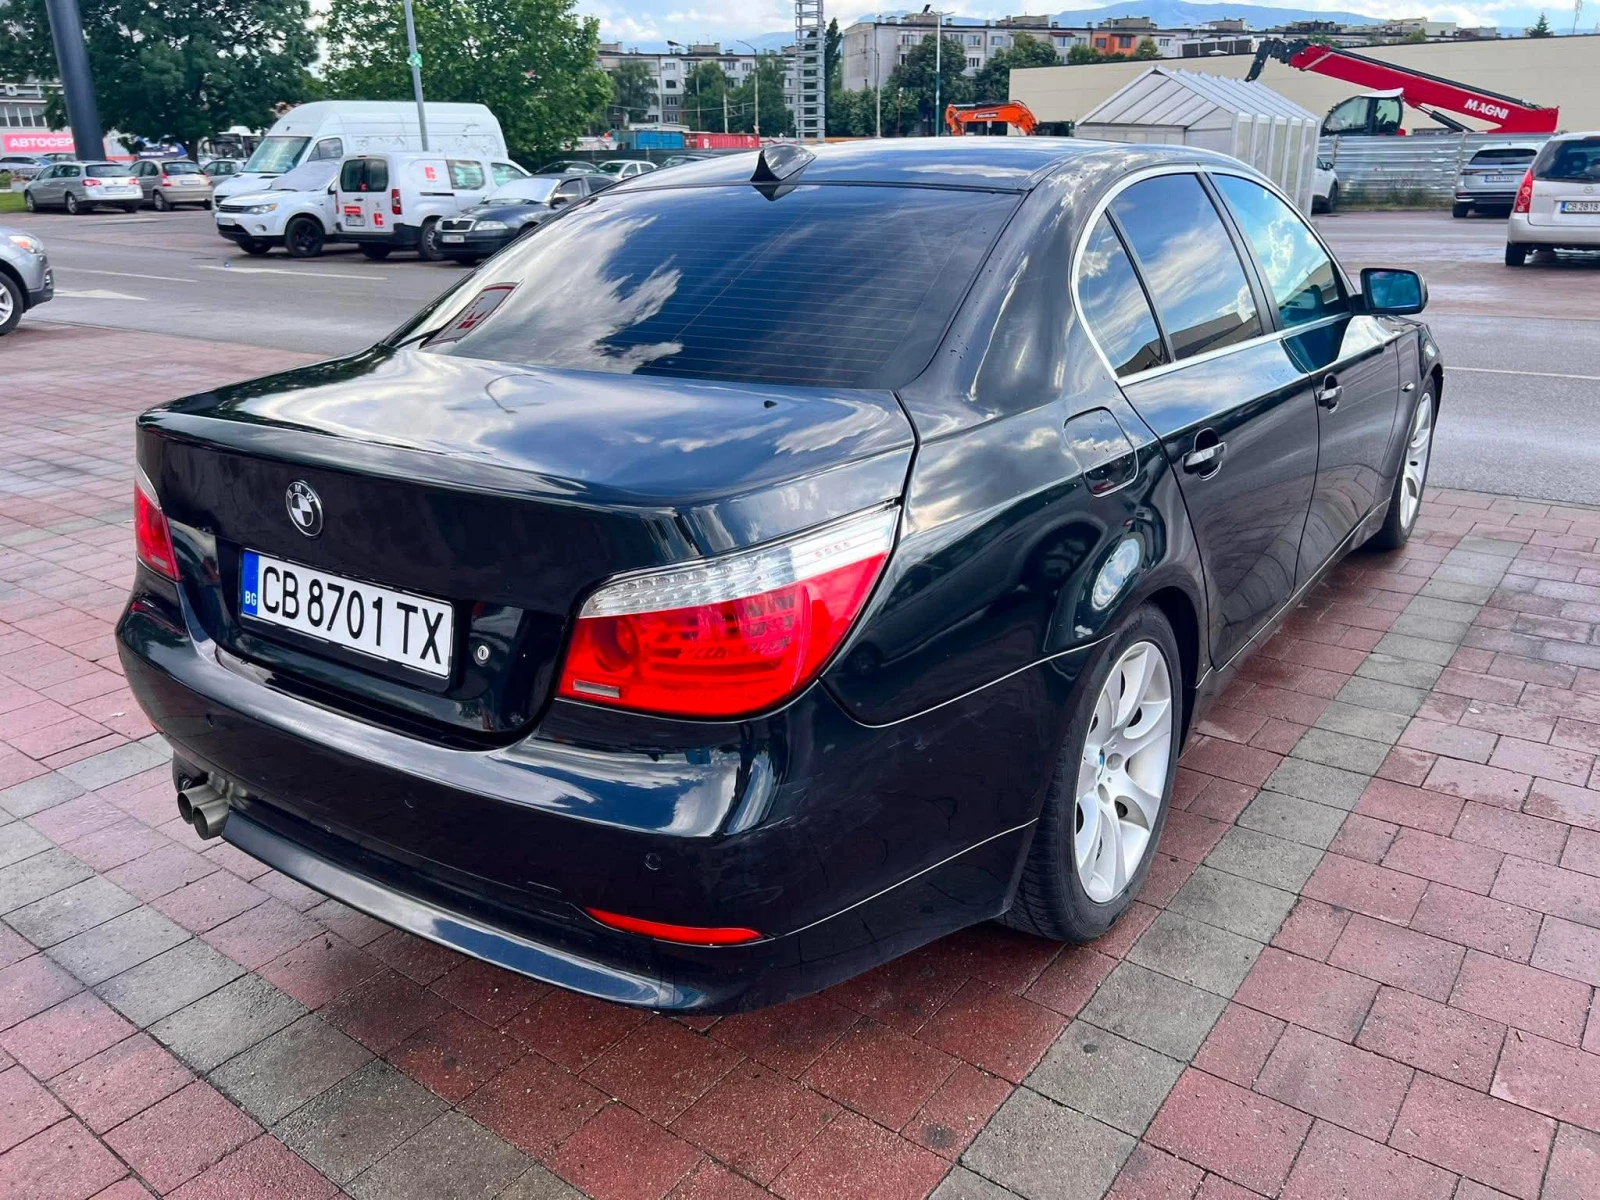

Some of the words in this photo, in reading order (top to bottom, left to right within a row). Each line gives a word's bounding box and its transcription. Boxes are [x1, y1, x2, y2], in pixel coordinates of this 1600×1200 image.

[1464, 99, 1509, 119] MAGNI
[286, 484, 315, 504] BMW
[245, 590, 256, 606] BG
